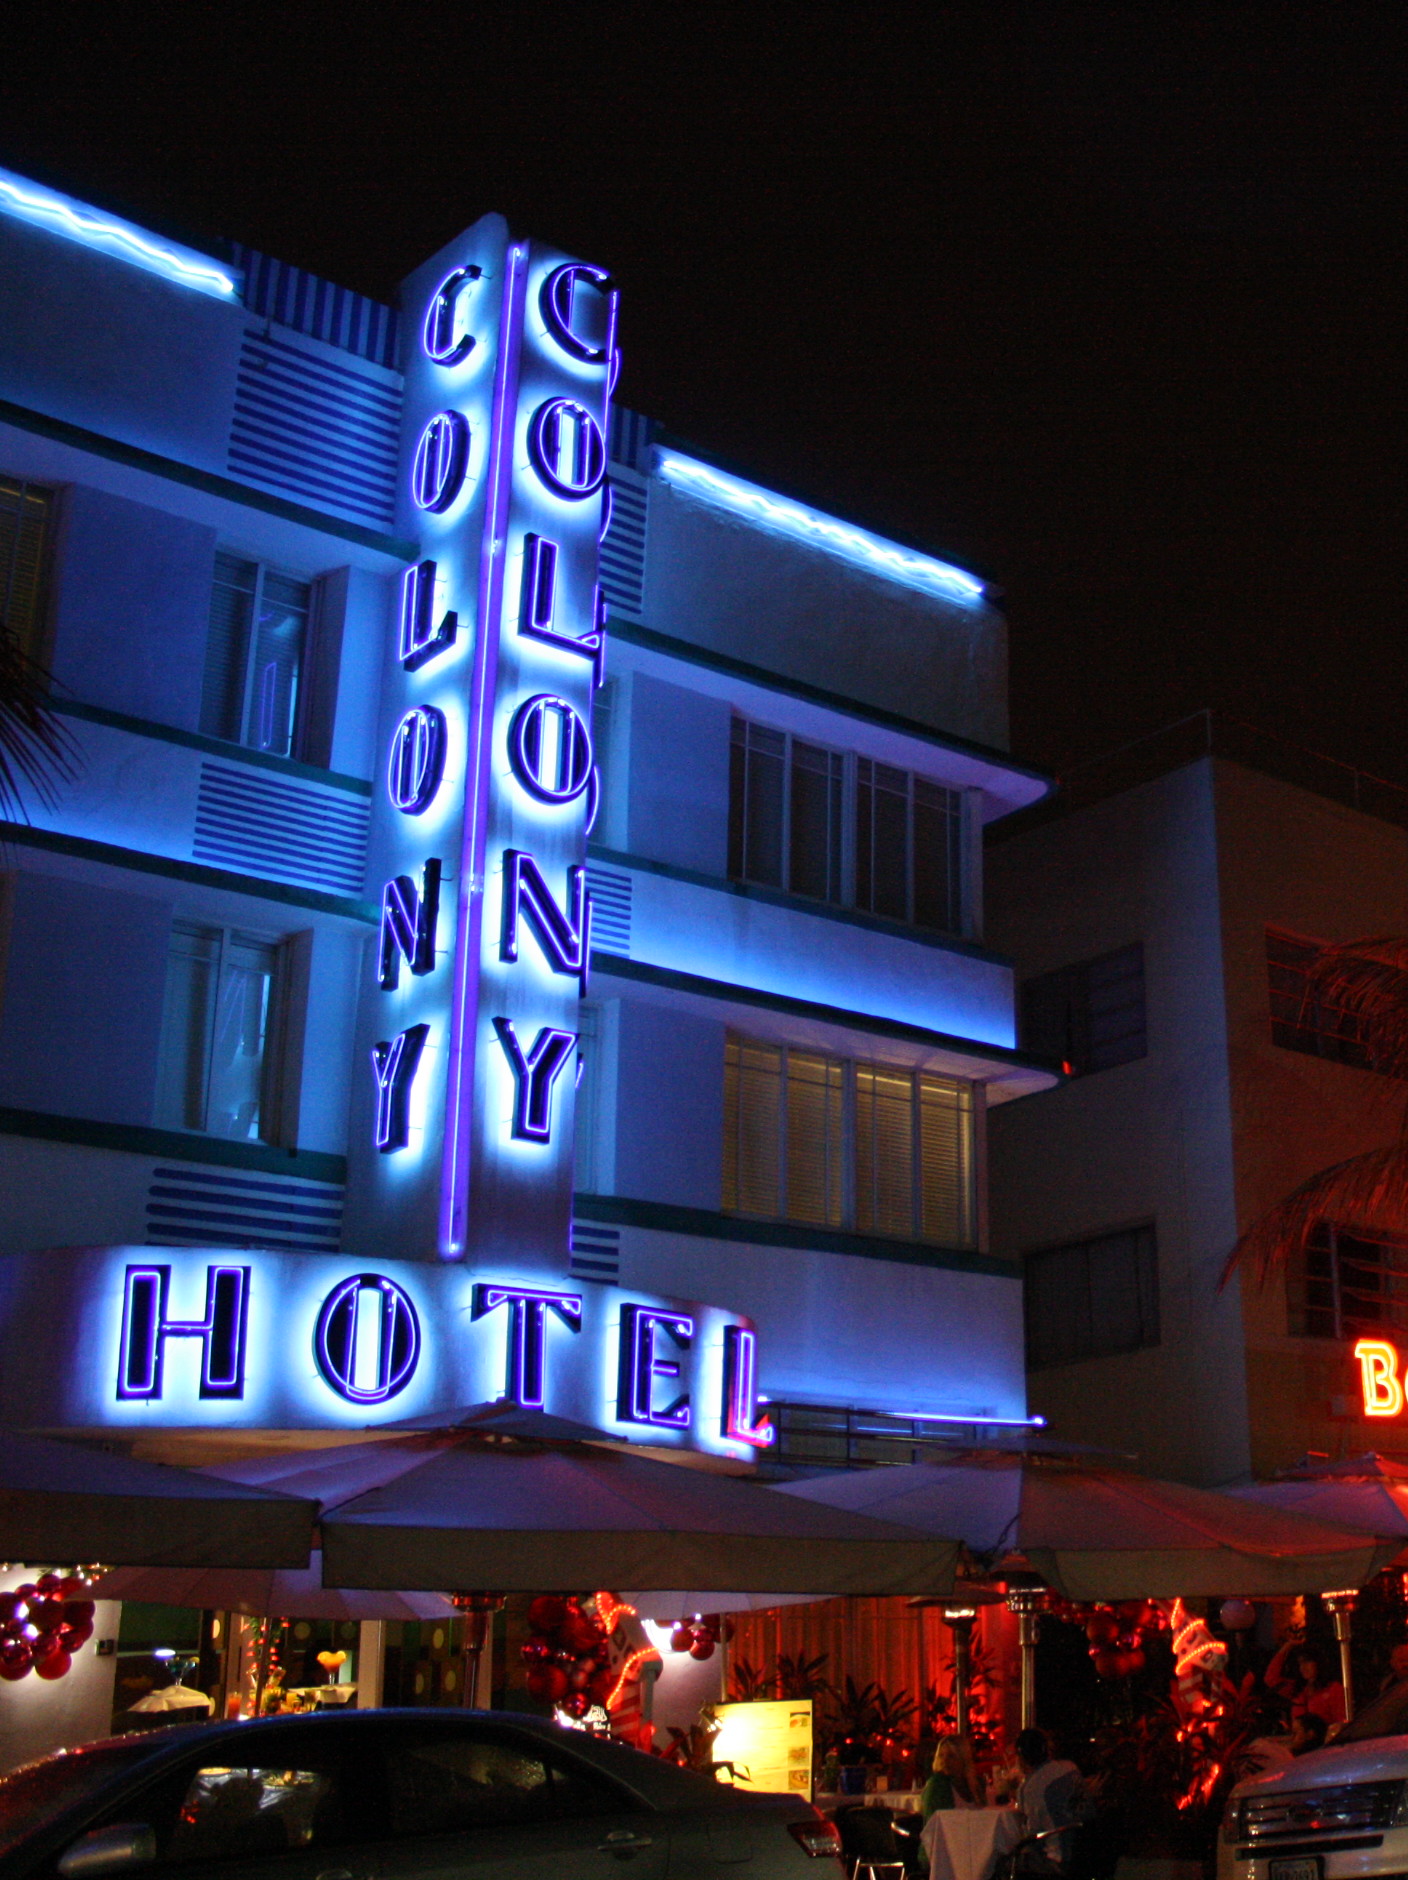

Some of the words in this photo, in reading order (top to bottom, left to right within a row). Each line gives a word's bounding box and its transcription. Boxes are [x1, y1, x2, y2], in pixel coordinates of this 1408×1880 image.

[372, 263, 482, 1154] COLONY
[492, 262, 616, 1146] COLONY
[116, 1264, 774, 1448] HOTEL
